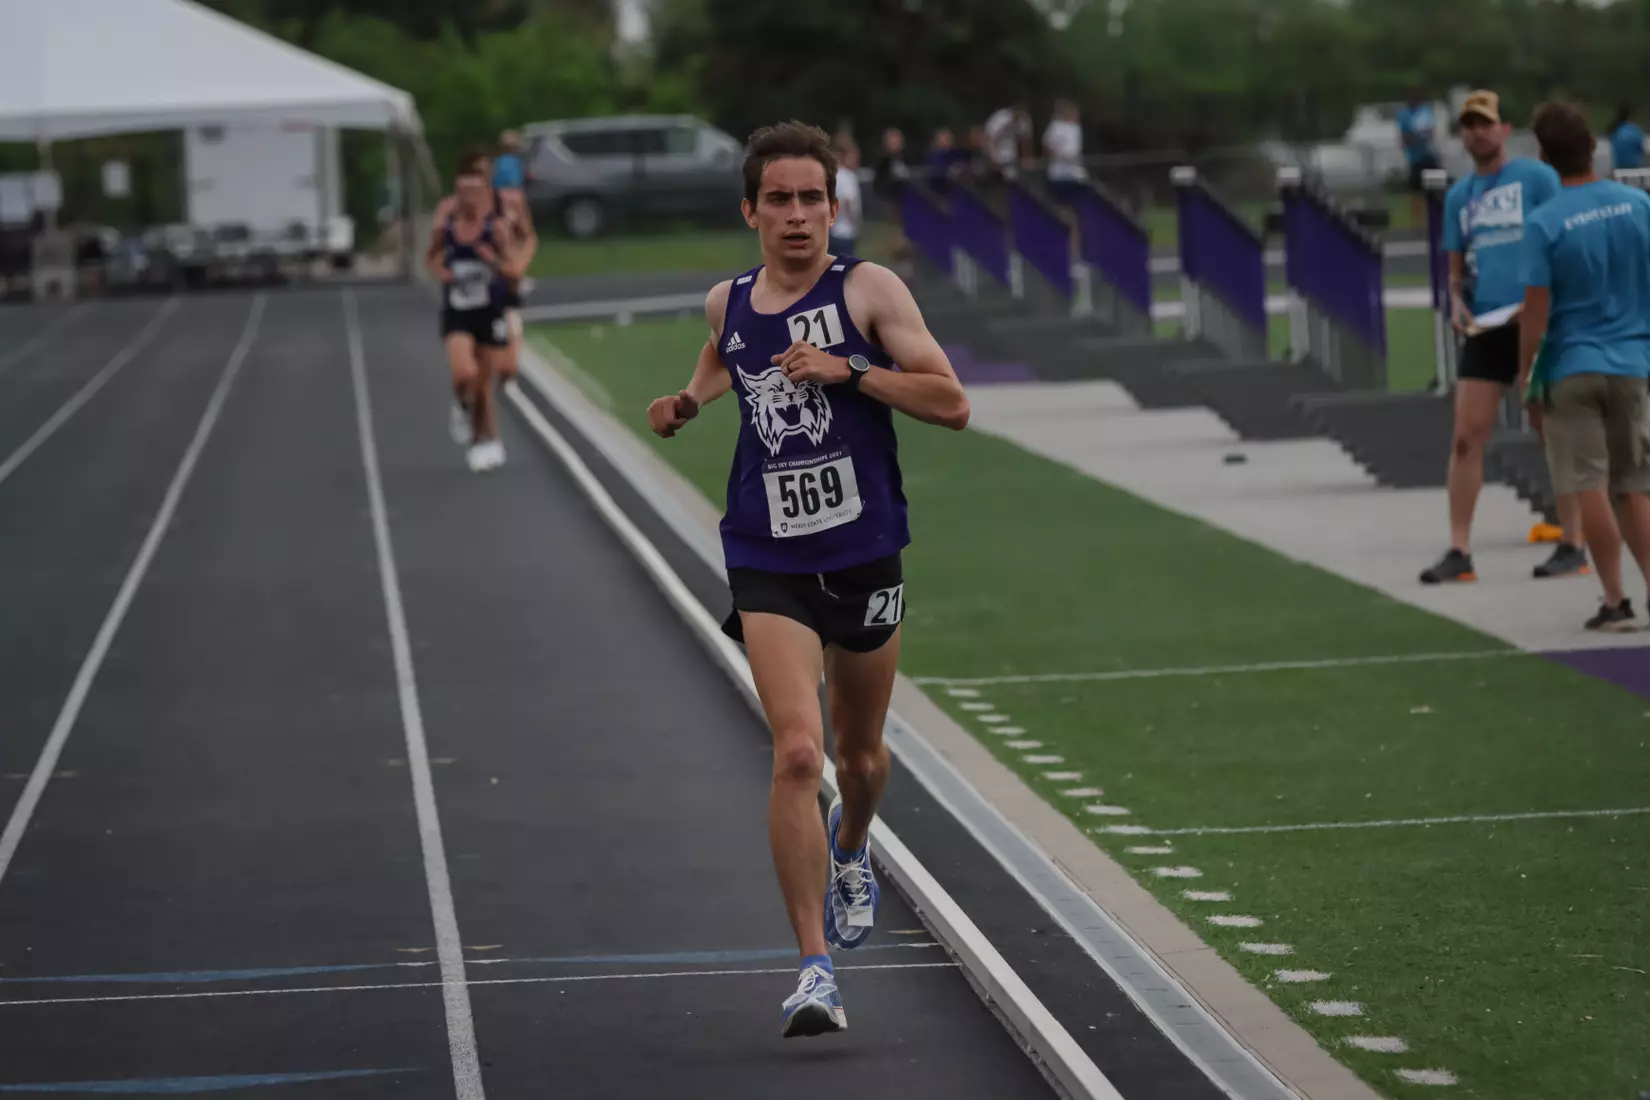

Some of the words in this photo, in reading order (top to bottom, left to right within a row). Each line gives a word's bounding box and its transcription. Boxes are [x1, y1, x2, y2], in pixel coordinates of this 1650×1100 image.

[793, 309, 832, 347] 21
[725, 342, 746, 354] adidas
[788, 455, 828, 467] CHAMPIONSHIPS
[778, 465, 844, 518] 569
[806, 518, 822, 528] STATE
[871, 587, 900, 624] 21
